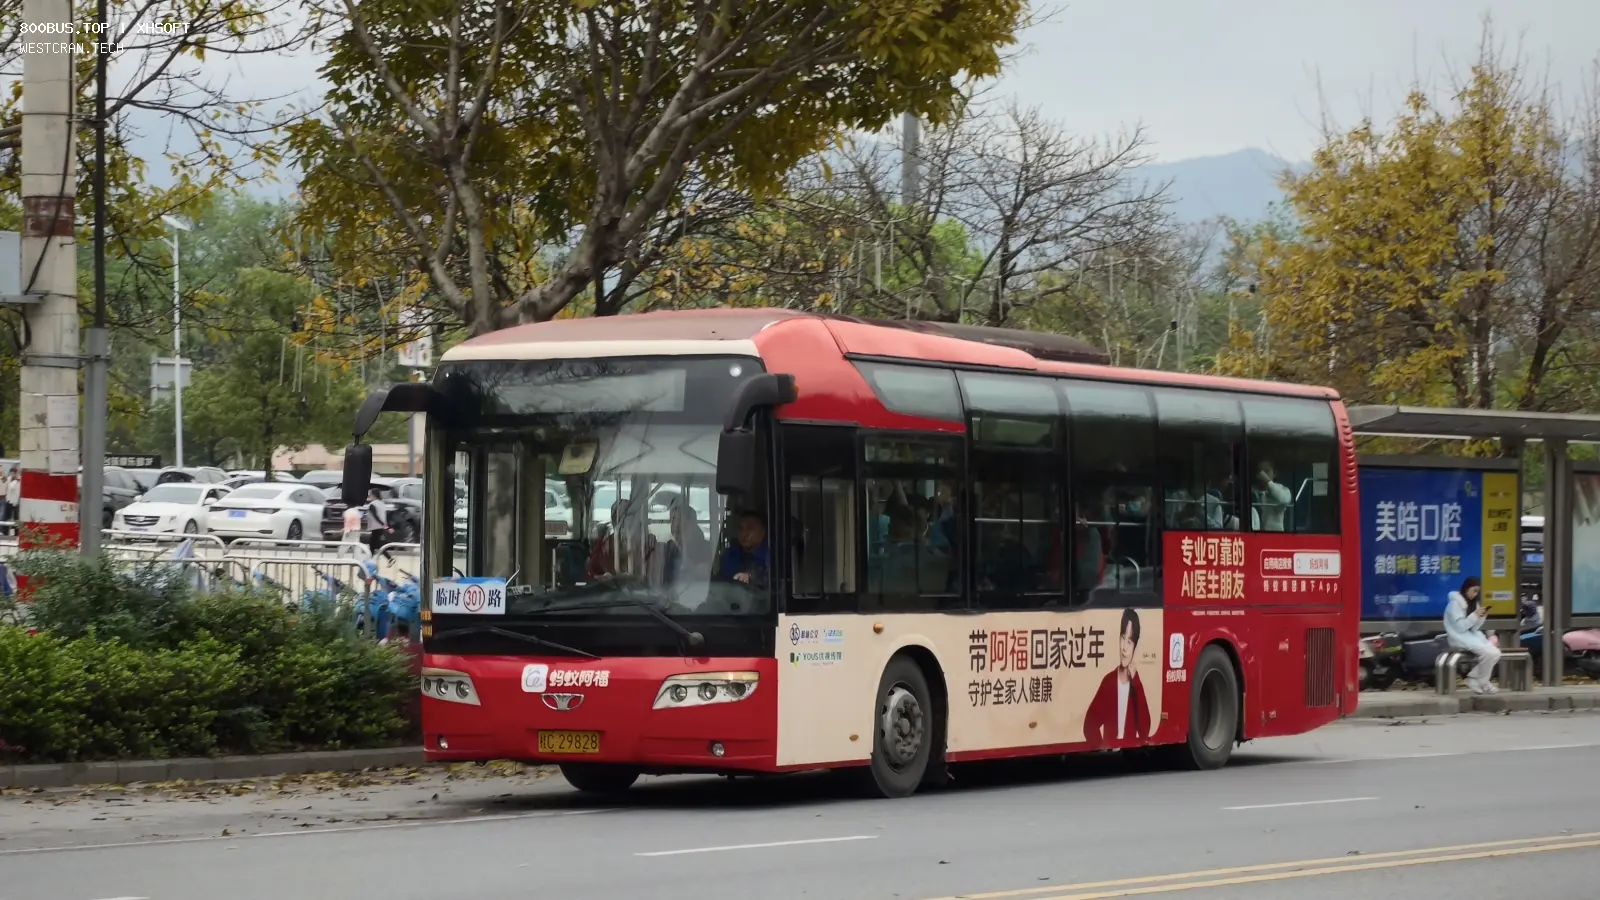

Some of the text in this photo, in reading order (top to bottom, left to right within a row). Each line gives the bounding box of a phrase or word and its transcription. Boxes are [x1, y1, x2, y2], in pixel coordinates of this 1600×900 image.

[1375, 500, 1462, 542] 美皓口腔
[1181, 536, 1245, 567] 专业可靠的
[1181, 569, 1245, 599] AI医生朋友
[968, 625, 1105, 674] 带阿福回家过年
[549, 669, 611, 688] 蚂蚁阿福
[968, 675, 1053, 707] 守护全家人健康
